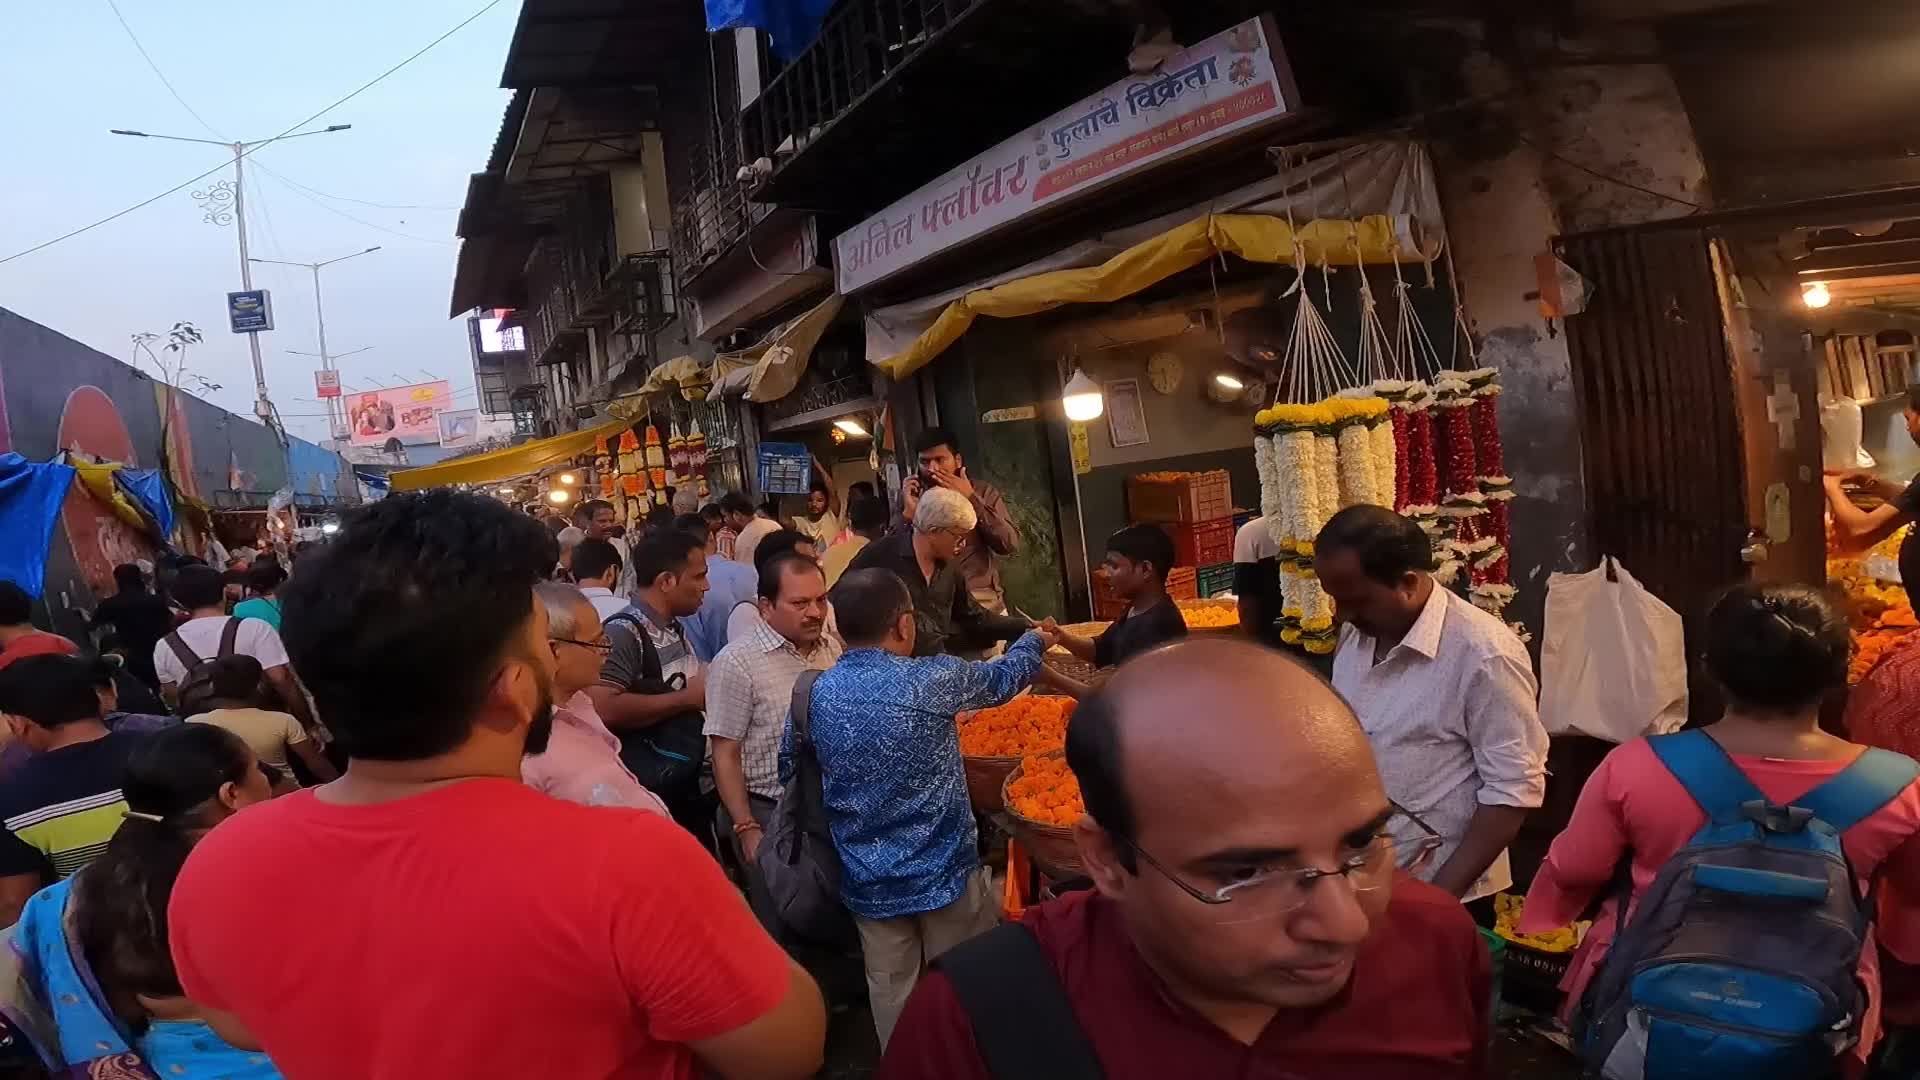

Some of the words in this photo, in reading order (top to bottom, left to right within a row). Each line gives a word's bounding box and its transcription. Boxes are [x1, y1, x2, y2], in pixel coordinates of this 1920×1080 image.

[1051, 96, 1120, 160] फुलांचे
[1125, 55, 1219, 116] विक्रेता
[847, 212, 916, 272] अनिल
[921, 154, 1030, 233] फ्लॉवर
